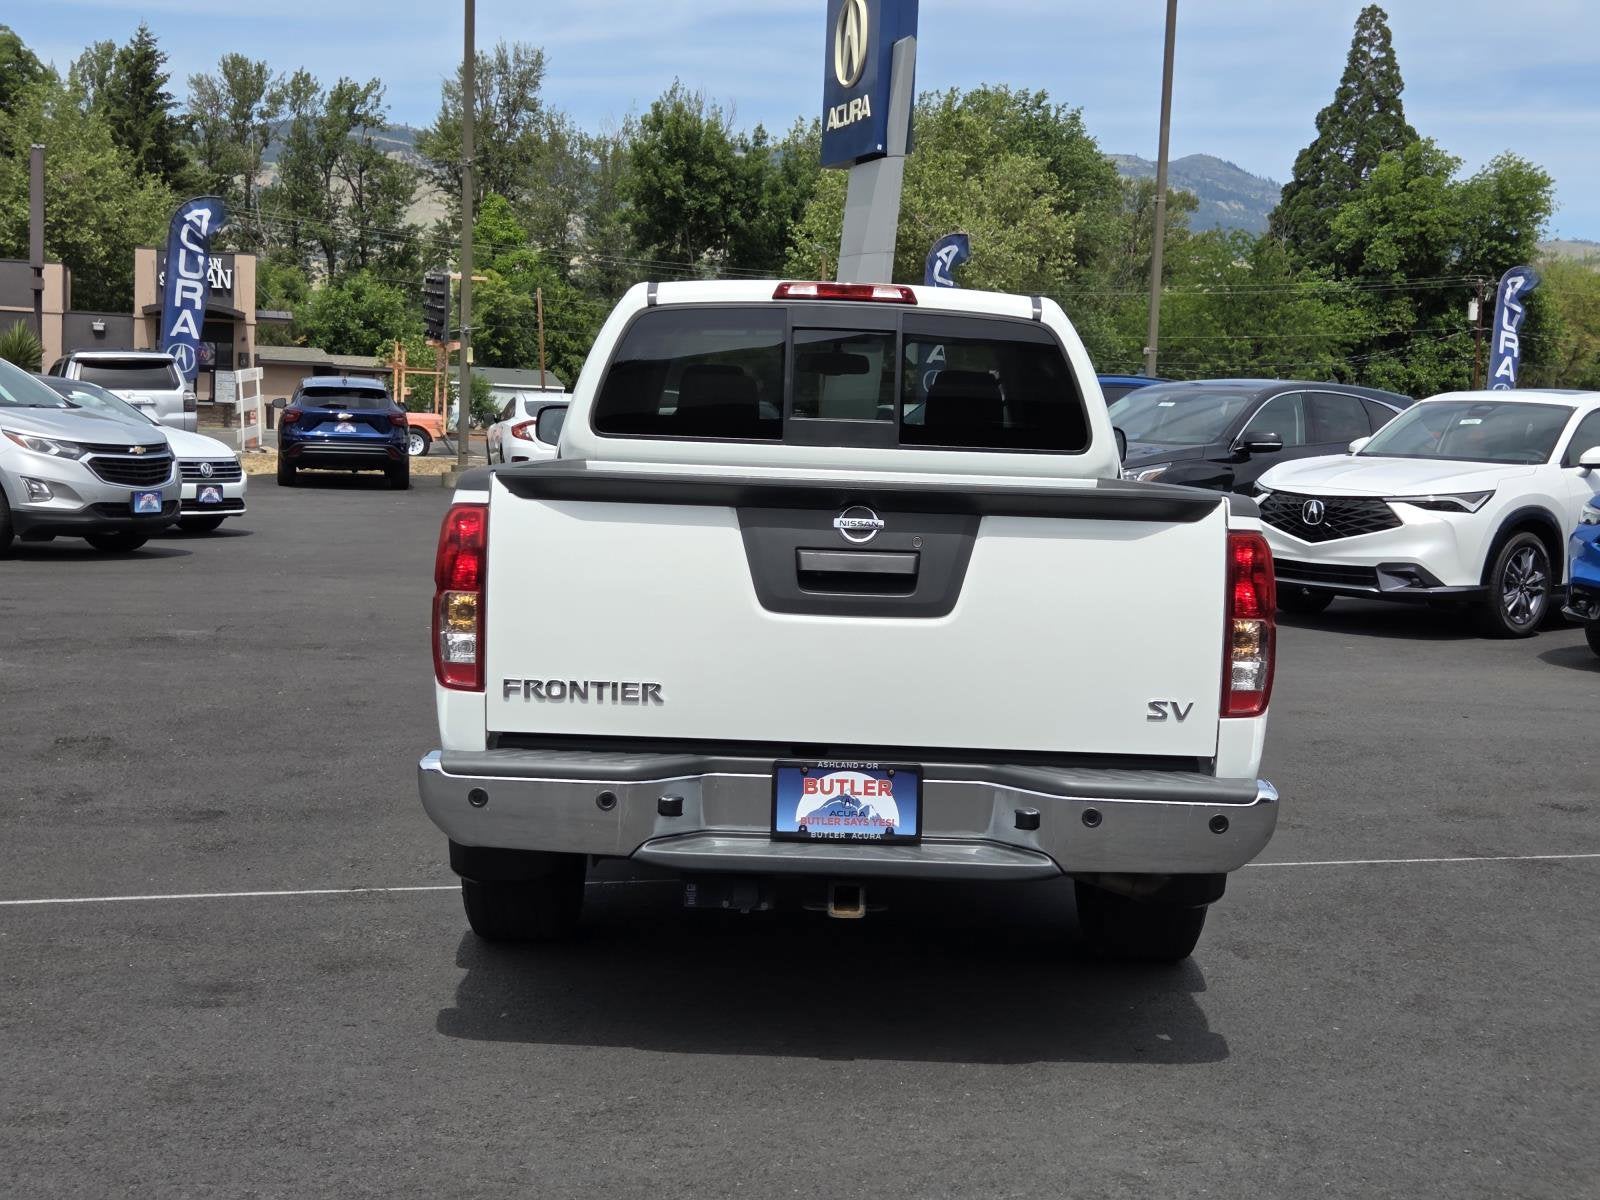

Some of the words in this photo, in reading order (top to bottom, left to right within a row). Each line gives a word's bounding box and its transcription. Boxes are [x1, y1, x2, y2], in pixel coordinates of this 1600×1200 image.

[827, 94, 870, 131] ACURA
[170, 208, 211, 339] ACURA
[839, 520, 880, 528] NISSAN
[502, 678, 664, 705] FRONTIER
[1146, 700, 1194, 722] SV
[817, 761, 859, 769] ASHLAND
[803, 777, 893, 797] BUTLER
[800, 816, 841, 827] BUTLER
[843, 816, 869, 827] SAYS
[870, 817, 895, 828] YES!
[810, 831, 846, 840] BUTLER
[851, 832, 882, 841] ACURA
